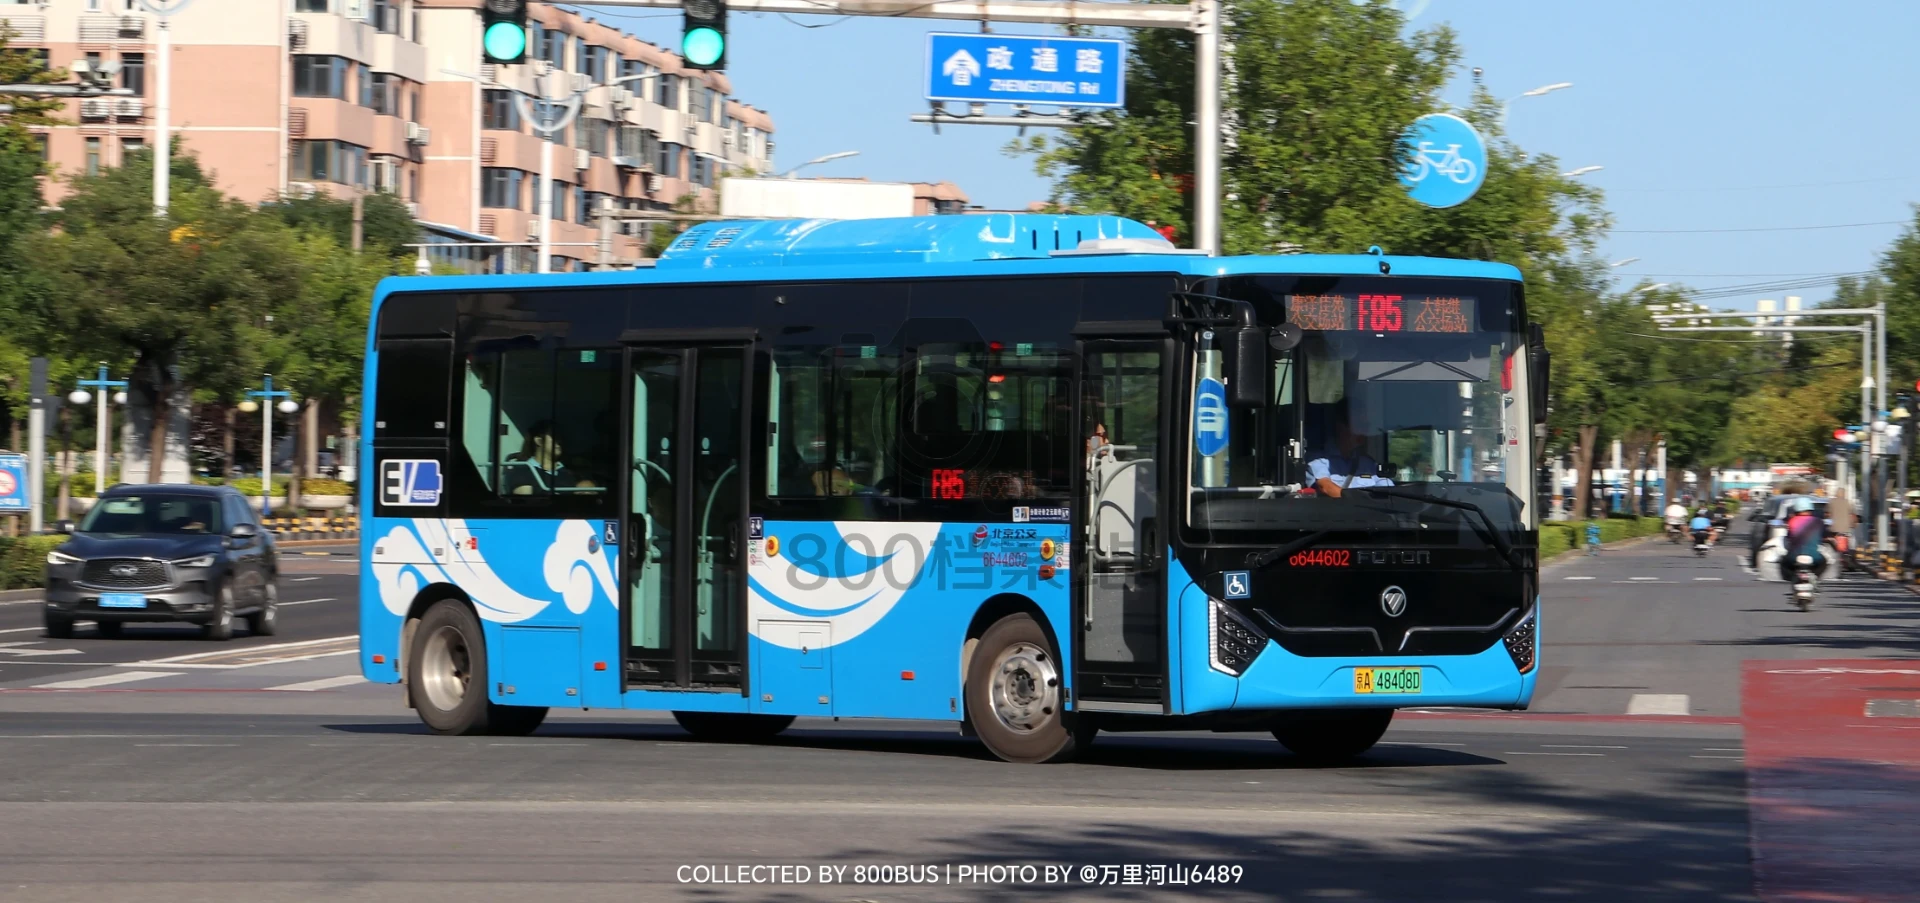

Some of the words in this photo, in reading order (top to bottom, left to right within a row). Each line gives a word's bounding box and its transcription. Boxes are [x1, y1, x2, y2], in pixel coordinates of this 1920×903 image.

[986, 46, 1103, 73] 政通路
[1291, 311, 1345, 331] 公交场站
[1358, 294, 1402, 331] F85
[1414, 311, 1468, 333] 公交场站
[932, 469, 965, 499] F85
[992, 528, 1037, 539] 北京公交
[983, 552, 1027, 567] 6644602
